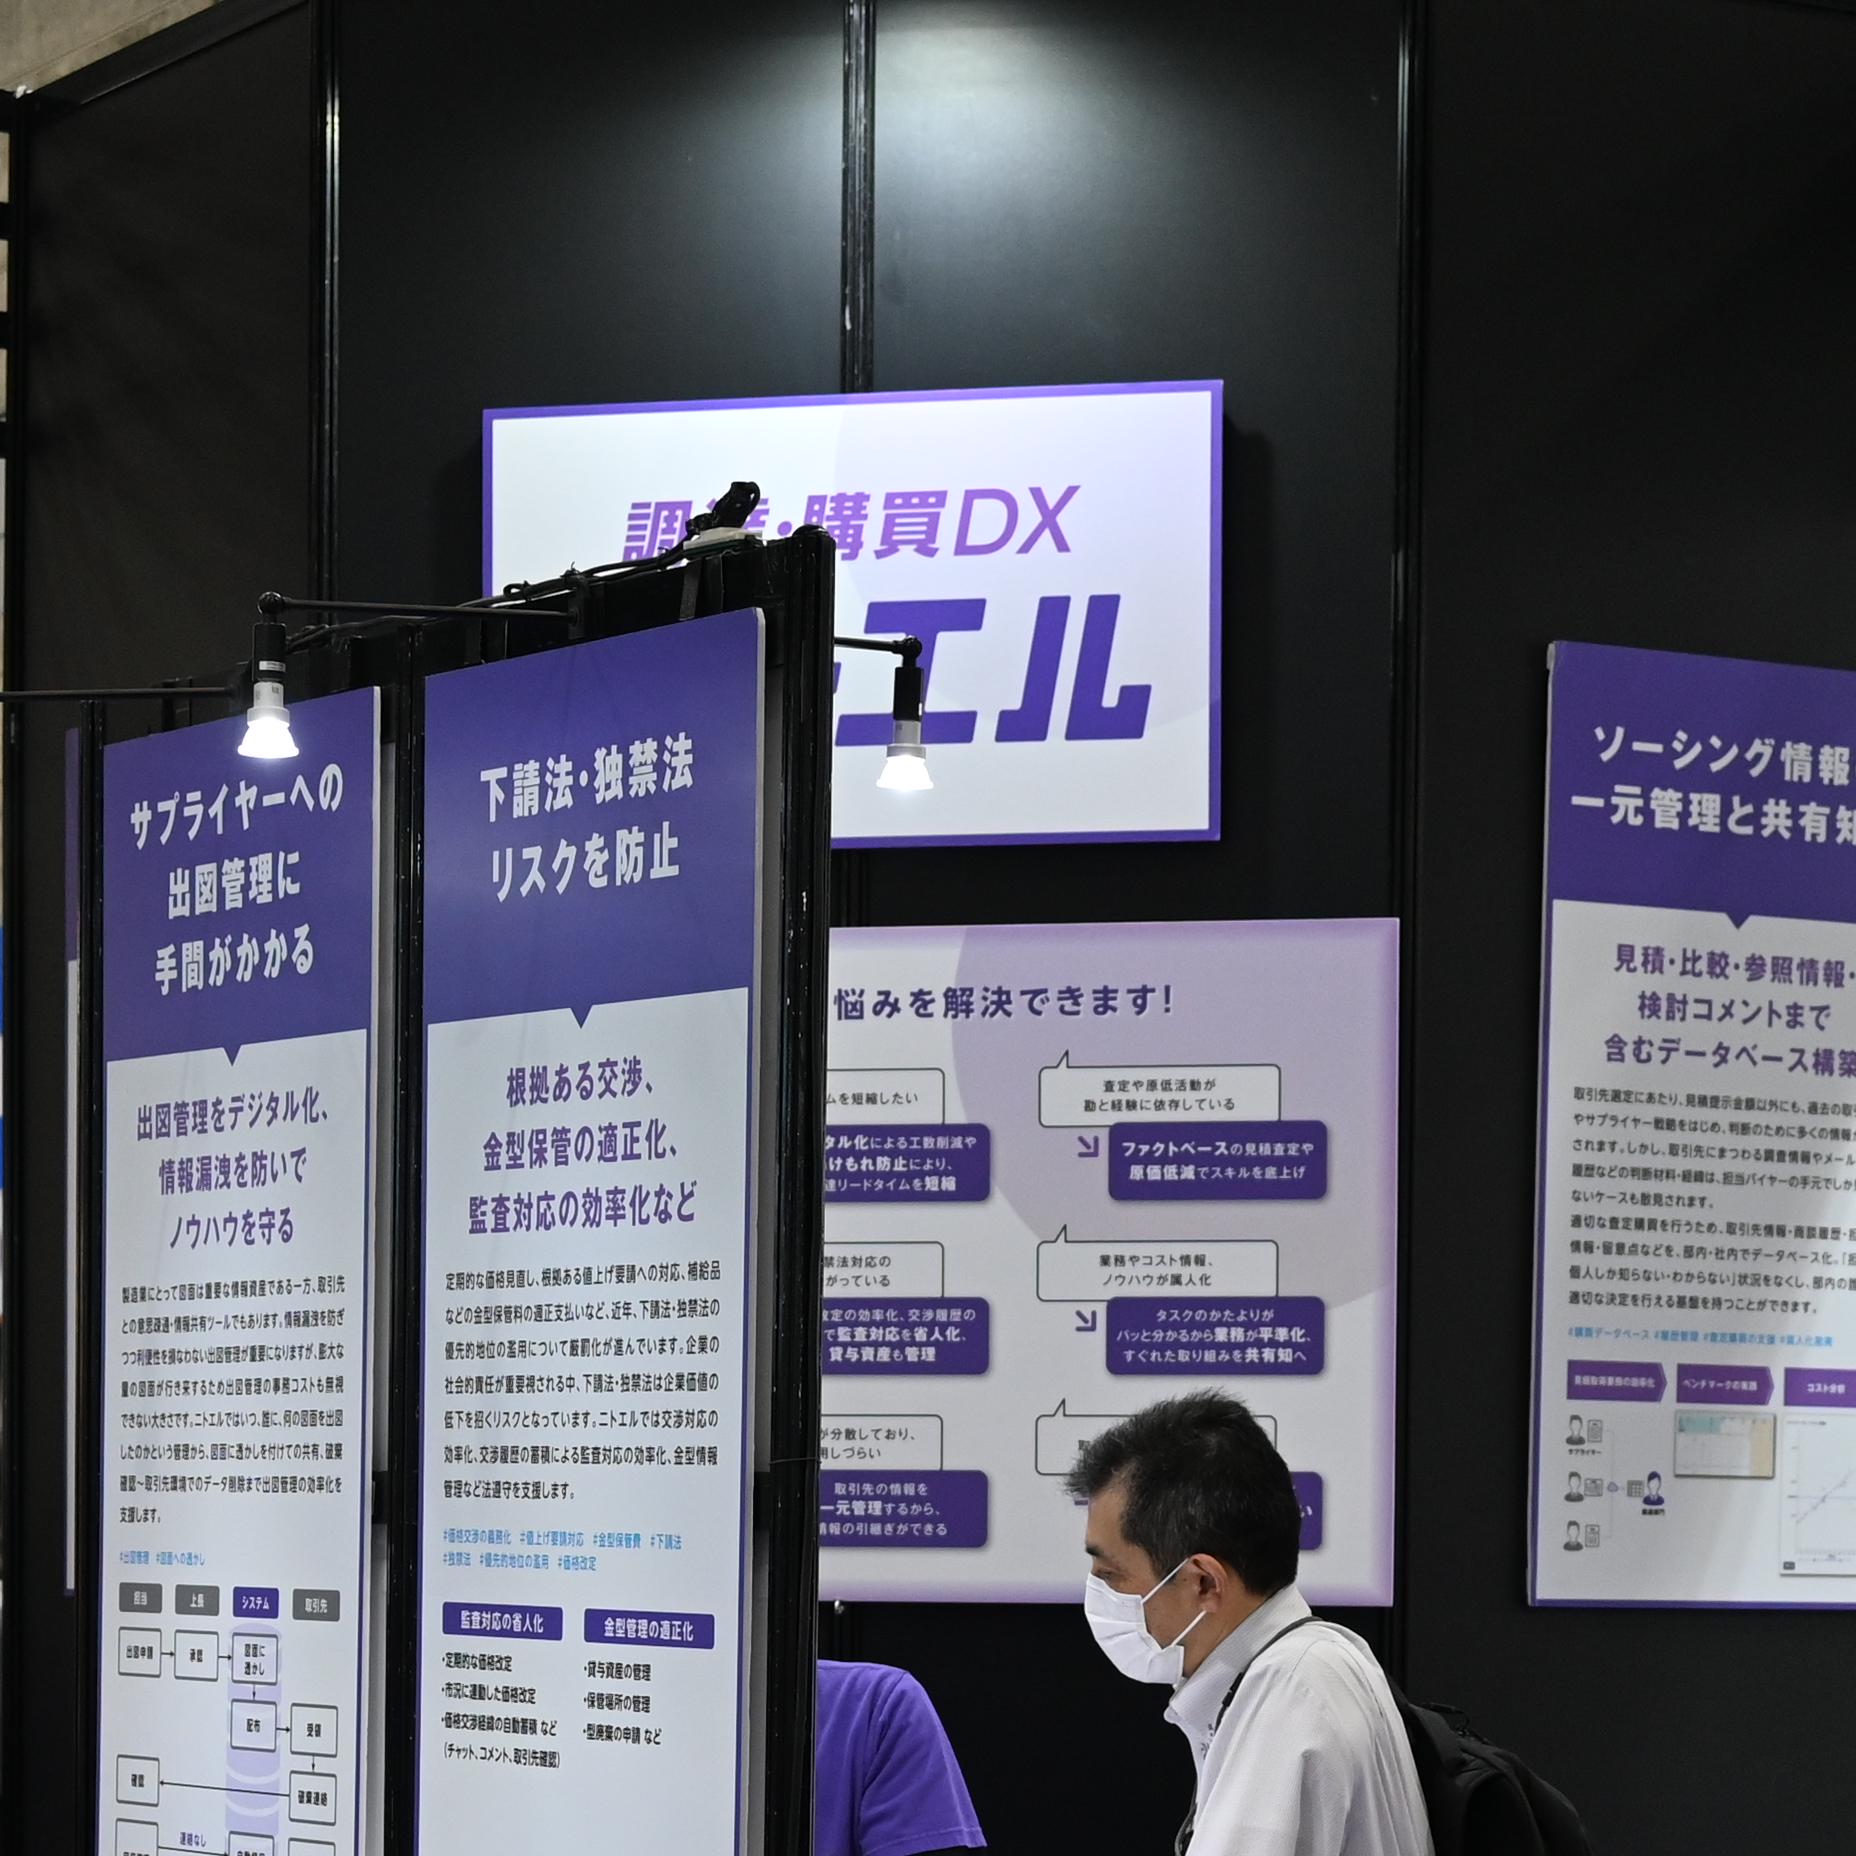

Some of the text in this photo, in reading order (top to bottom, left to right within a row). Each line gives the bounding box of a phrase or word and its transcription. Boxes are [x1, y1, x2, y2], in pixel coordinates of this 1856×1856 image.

[622, 486, 1080, 564] 調・購買DX
[834, 593, 1152, 747] エル
[480, 731, 695, 824] 下請法・独禁法
[130, 762, 344, 851] サプライヤーへの
[492, 823, 681, 903] リスクを防止
[168, 850, 300, 920] 出図管理に
[155, 923, 314, 996] 手間がかかる
[1614, 943, 1856, 989] 見積・比較・参照情報・
[834, 984, 1173, 1021] 悩みを解決できます!
[1637, 991, 1832, 1032] 検討コメントまで
[506, 1055, 656, 1108] 根拠ある交渉、
[1103, 1079, 1217, 1093] 査定や原低活動が
[136, 1086, 330, 1142] 出図管理をデジタル化、
[1083, 1098, 1236, 1113] 勘と経験に依存している
[482, 1120, 680, 1174] 金型保管の適正化、
[1121, 1141, 1315, 1158] ファクトベースの見積査定や
[159, 1147, 307, 1195] 情報漏洩を防いで
[824, 1156, 953, 1172] けもれ防止により、
[1128, 1164, 1306, 1181] 原価低減でスキルを底上げ
[468, 1182, 697, 1236] 監査対応の効率化など
[169, 1206, 294, 1249] ノウハウを守る
[445, 1260, 721, 1291] 定期的な価格見直し、根拠ある値上げ要請への対応、補給品
[1099, 1253, 1214, 1268] 業務やコスト情報、
[1102, 1272, 1213, 1287] ノウハウが属人化
[1156, 1308, 1275, 1323] タスクのかたよりが
[824, 1326, 967, 1342] で監査対応を省人化、
[828, 1347, 937, 1362] 貸与資産も管理
[1123, 1347, 1307, 1364] すぐれた取り組みを共有知へ
[444, 1410, 718, 1429] 低下を招くリスクとなっています。ニトエルでは交渉対応の
[444, 1480, 575, 1500] 管理など法遵守を支援します。
[834, 1482, 929, 1497] 取引先の情報を
[119, 1507, 161, 1524] 支援します。
[820, 1500, 941, 1516] 一元管理するから、
[241, 1596, 270, 1611] システム
[460, 1610, 694, 1642] 監査対応の省人化 金型管理の適正化
